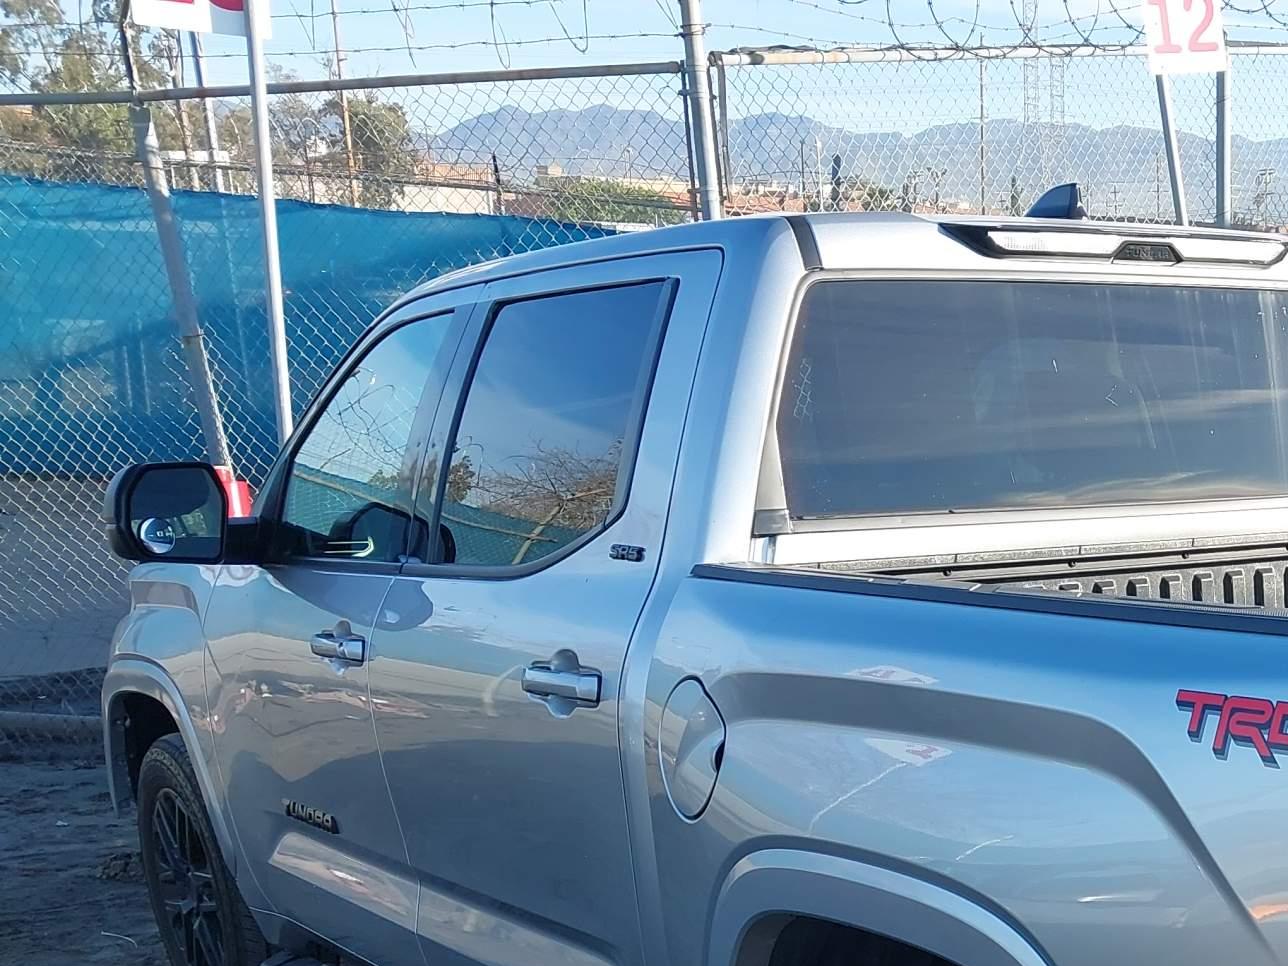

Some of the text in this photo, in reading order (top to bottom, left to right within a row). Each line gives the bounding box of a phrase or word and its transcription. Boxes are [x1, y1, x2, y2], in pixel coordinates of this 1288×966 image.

[1148, 0, 1219, 54] 12
[609, 543, 646, 562] SR5
[281, 799, 340, 834] TUNDRA
